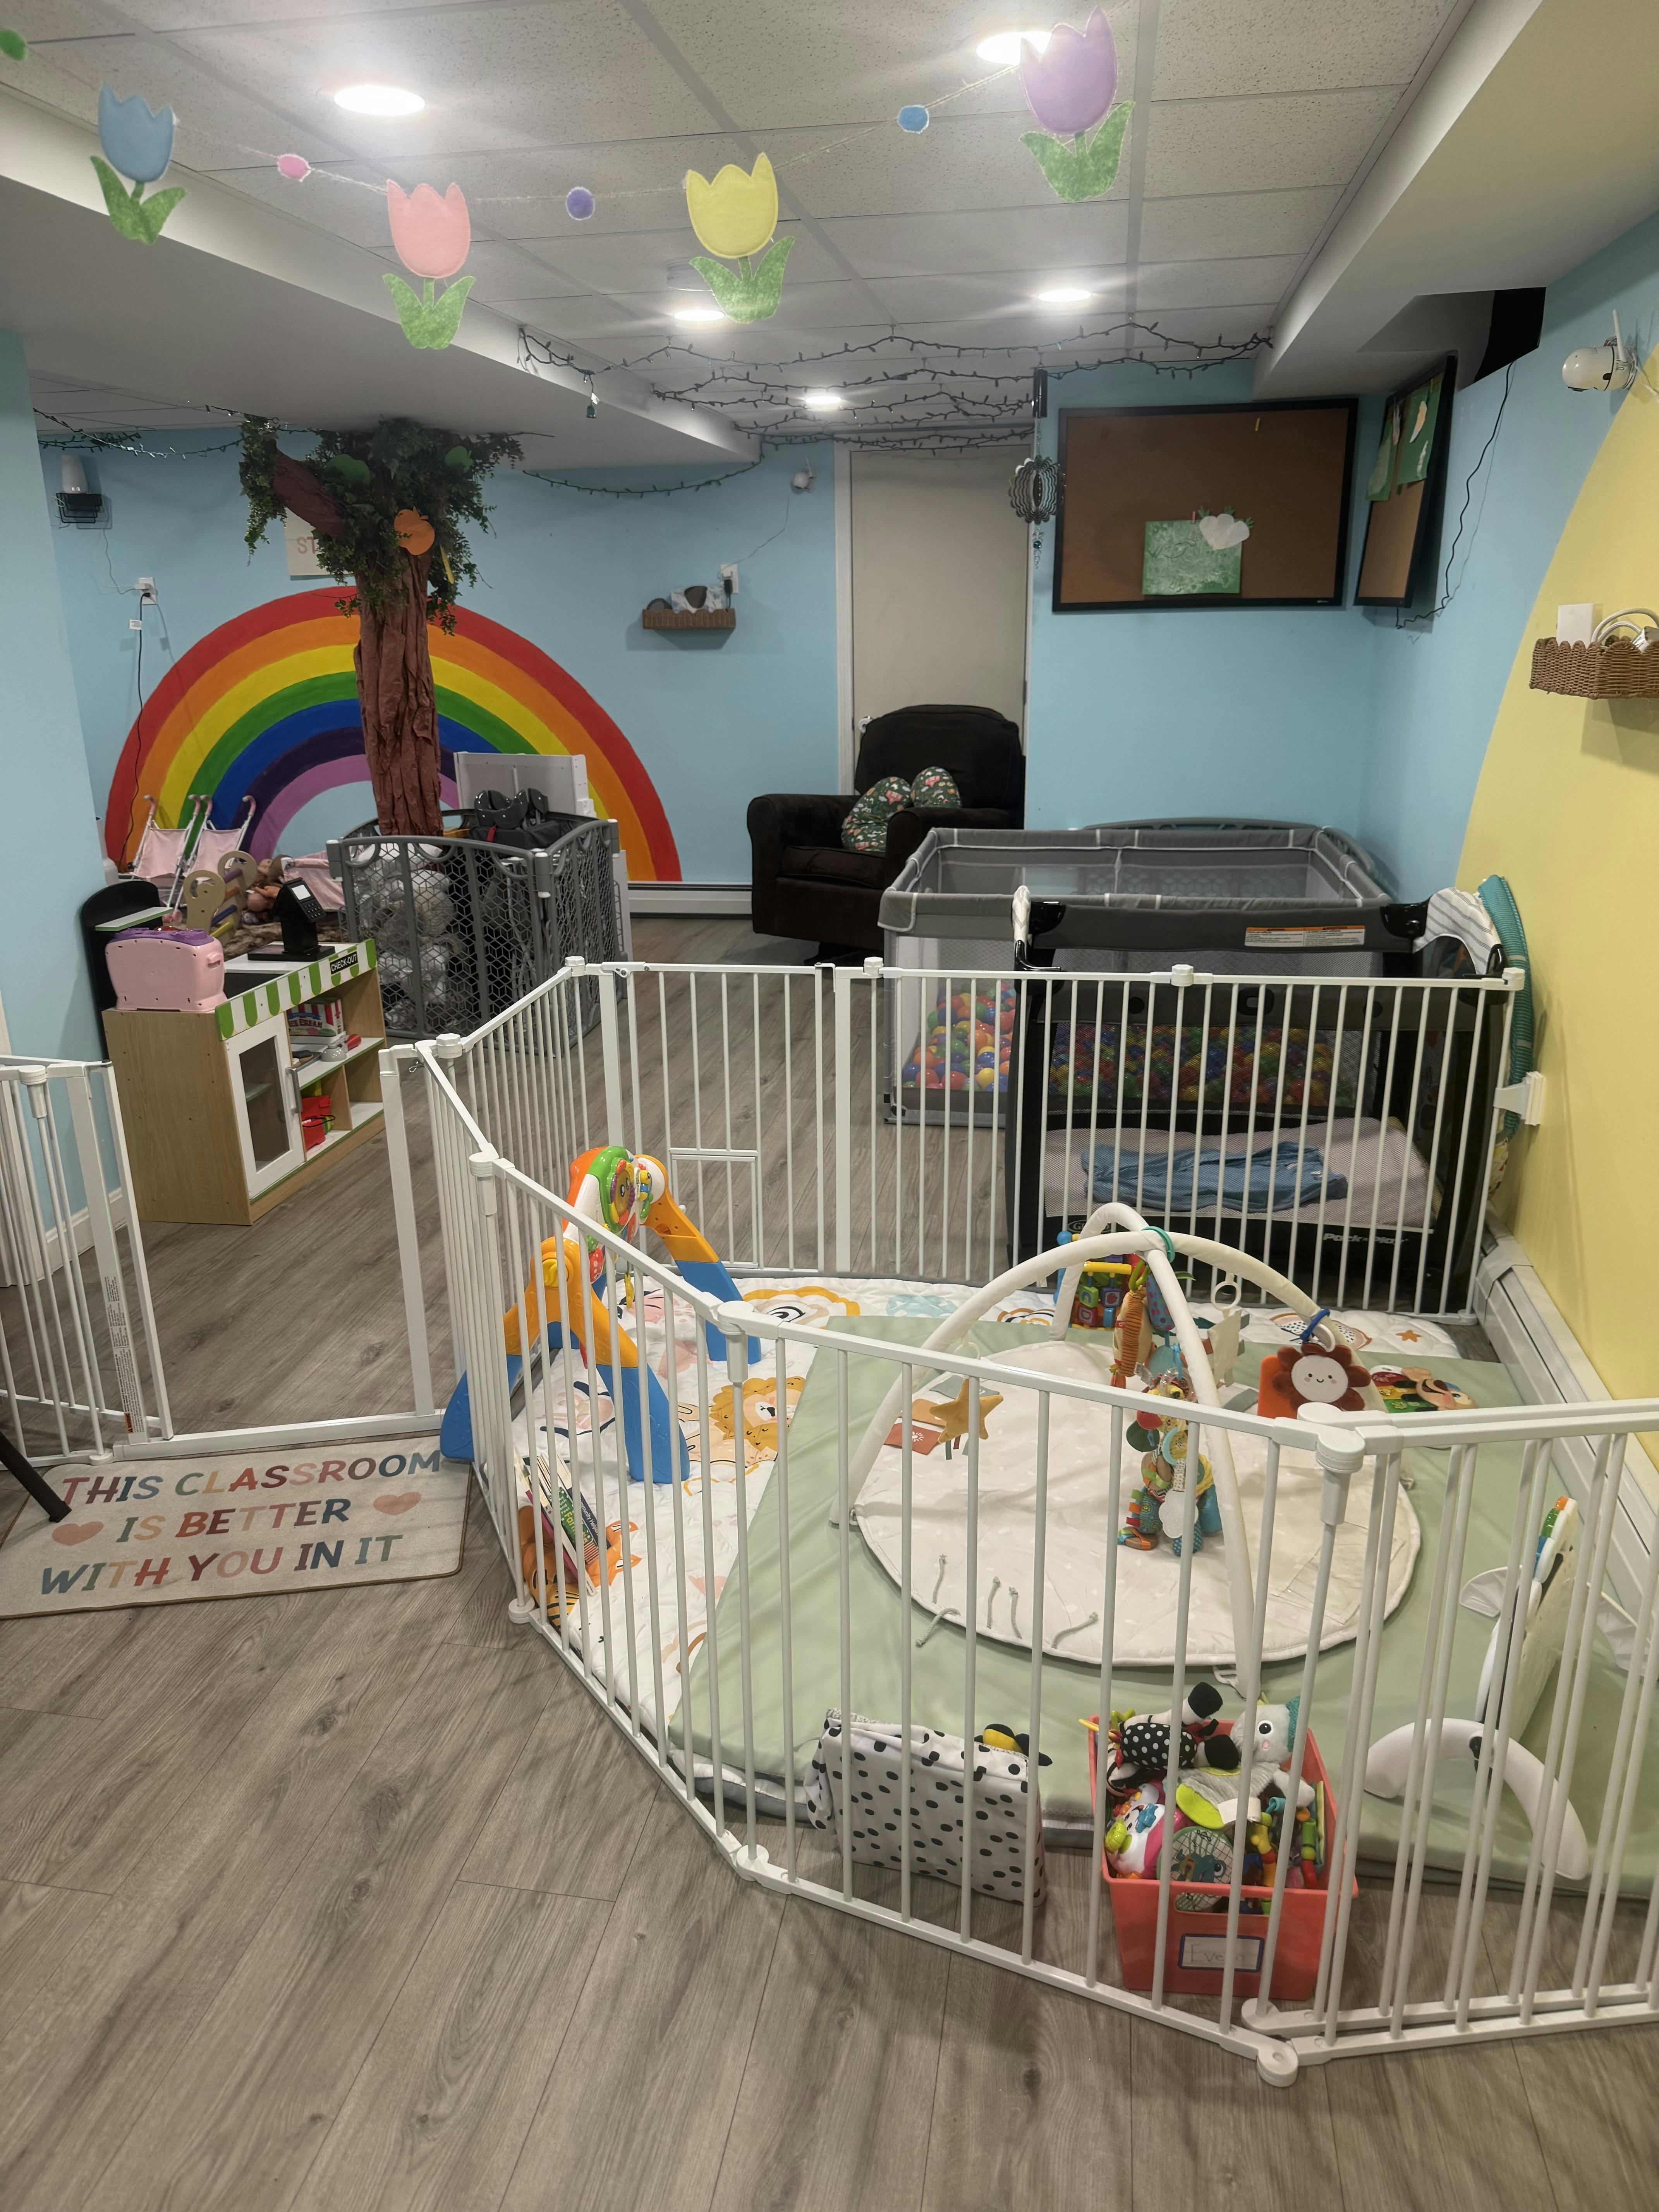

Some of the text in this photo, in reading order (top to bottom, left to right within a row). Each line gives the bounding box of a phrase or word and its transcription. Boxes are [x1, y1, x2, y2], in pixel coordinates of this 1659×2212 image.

[297, 536, 315, 554] ST
[331, 954, 357, 972] CHECK-OUT
[299, 1019, 322, 1028] CREAM
[63, 1450, 440, 1505] THIS CLASSROOM
[116, 1498, 351, 1542] IS BETTER
[580, 1500, 591, 1520] mmunity
[41, 1535, 403, 1595] WITH YOU IN IT
